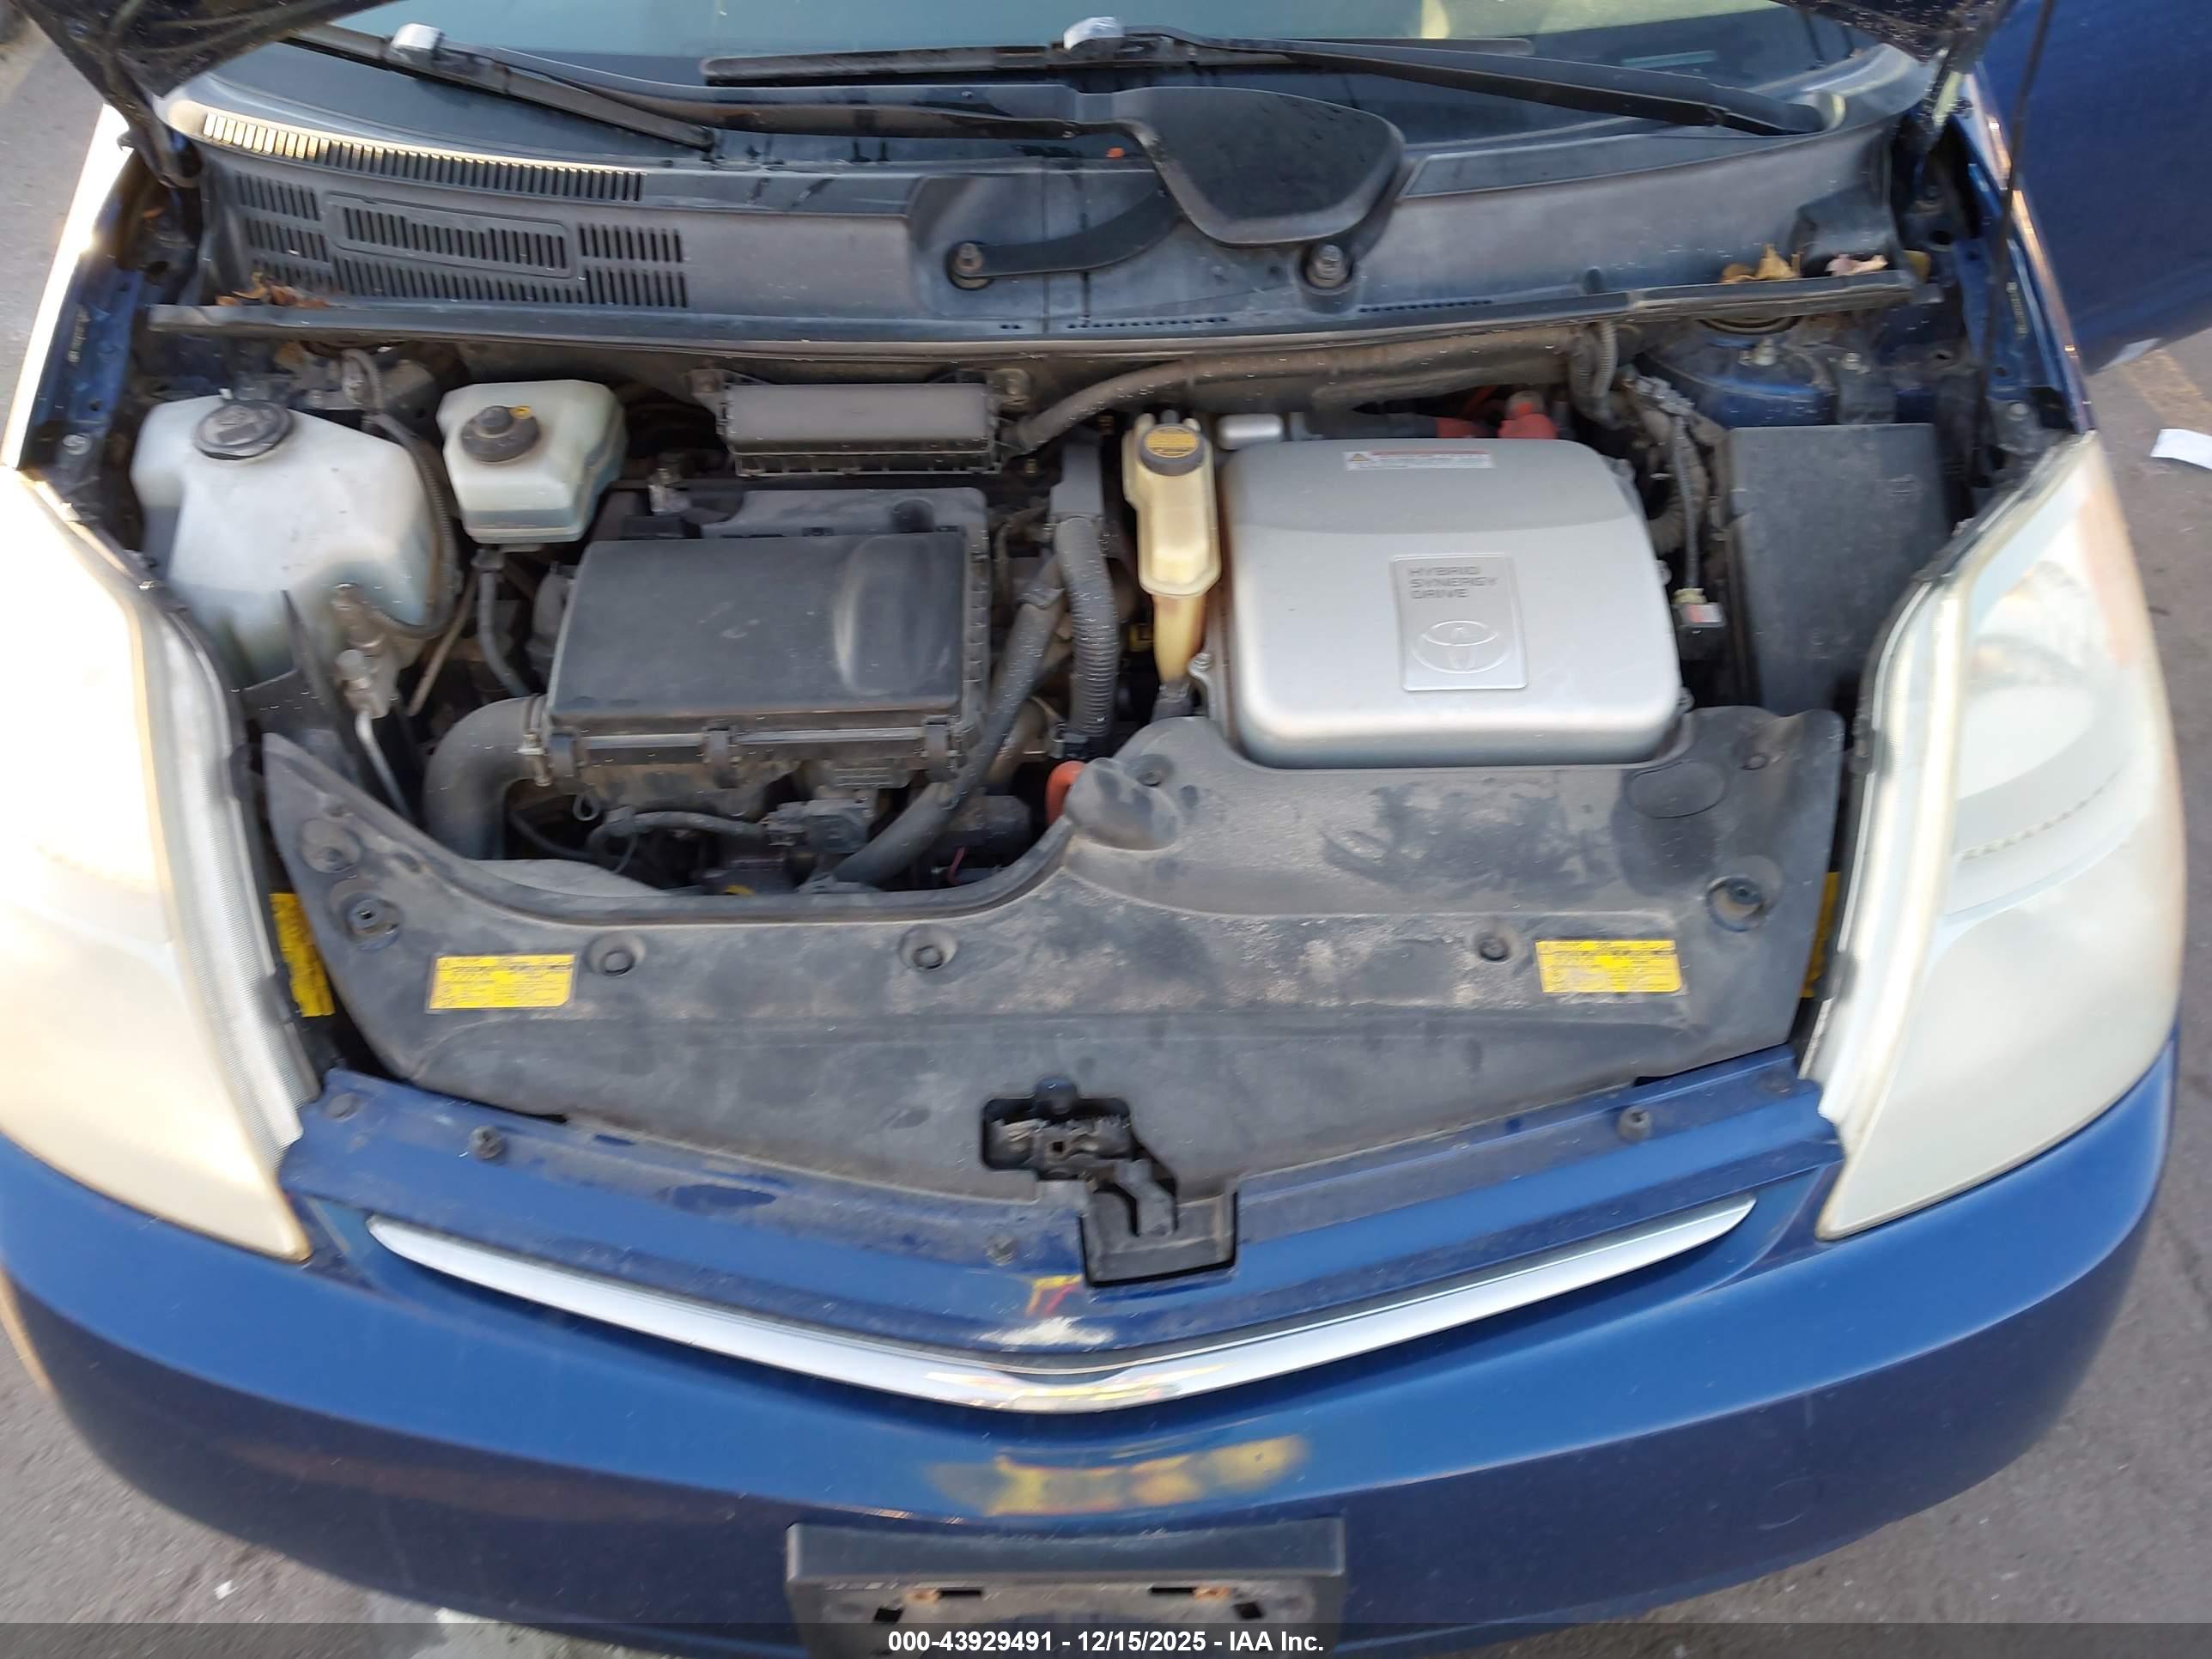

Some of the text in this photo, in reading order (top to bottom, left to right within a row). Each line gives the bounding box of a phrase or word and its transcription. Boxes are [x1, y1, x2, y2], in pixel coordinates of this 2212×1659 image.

[1409, 566, 1480, 576] HYBRID
[1410, 577, 1498, 587] SYNERGY
[1411, 588, 1469, 599] DRIVE
